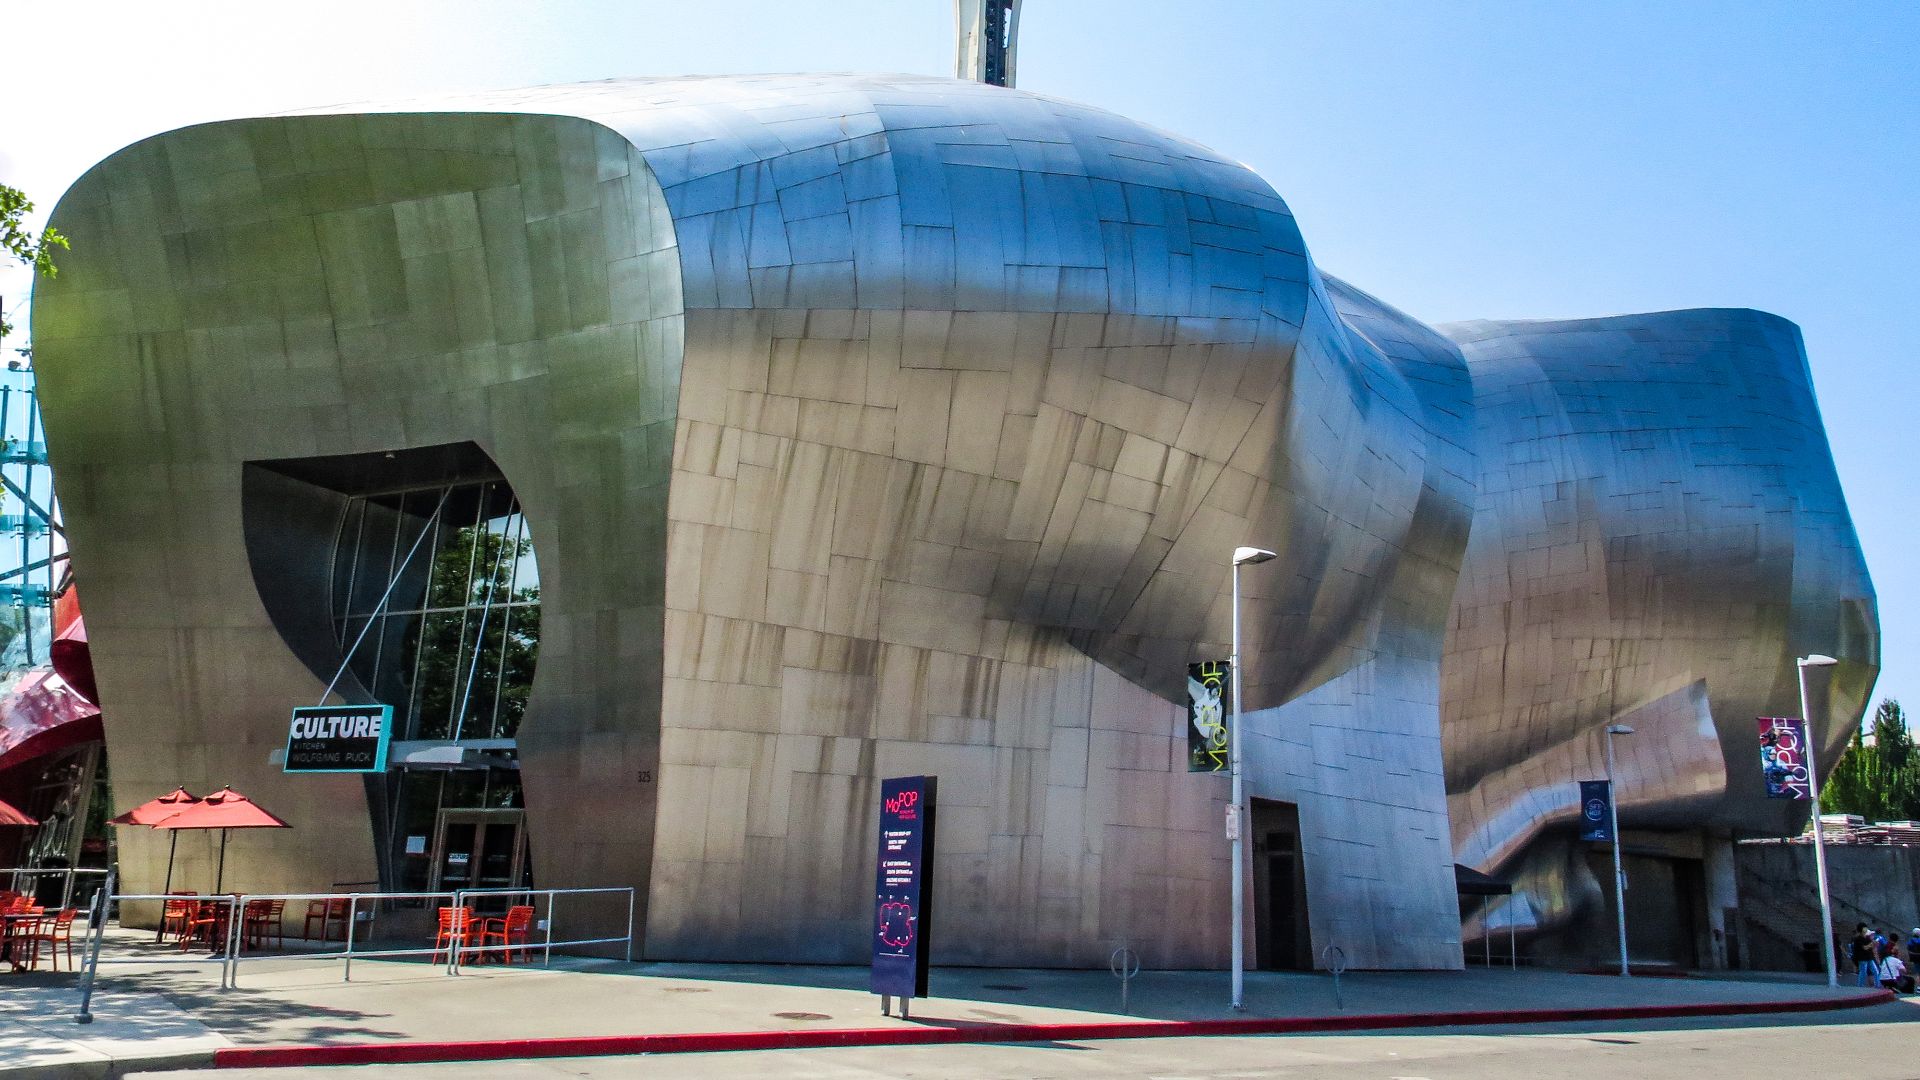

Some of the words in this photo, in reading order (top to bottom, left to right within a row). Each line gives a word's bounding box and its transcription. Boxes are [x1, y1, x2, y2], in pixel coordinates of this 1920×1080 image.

[290, 715, 383, 739] CULTURE
[293, 742, 326, 750] KITCHEN
[292, 752, 341, 762] WOLFGANG
[345, 752, 371, 762] PUCK
[885, 791, 918, 814] MoPOP
